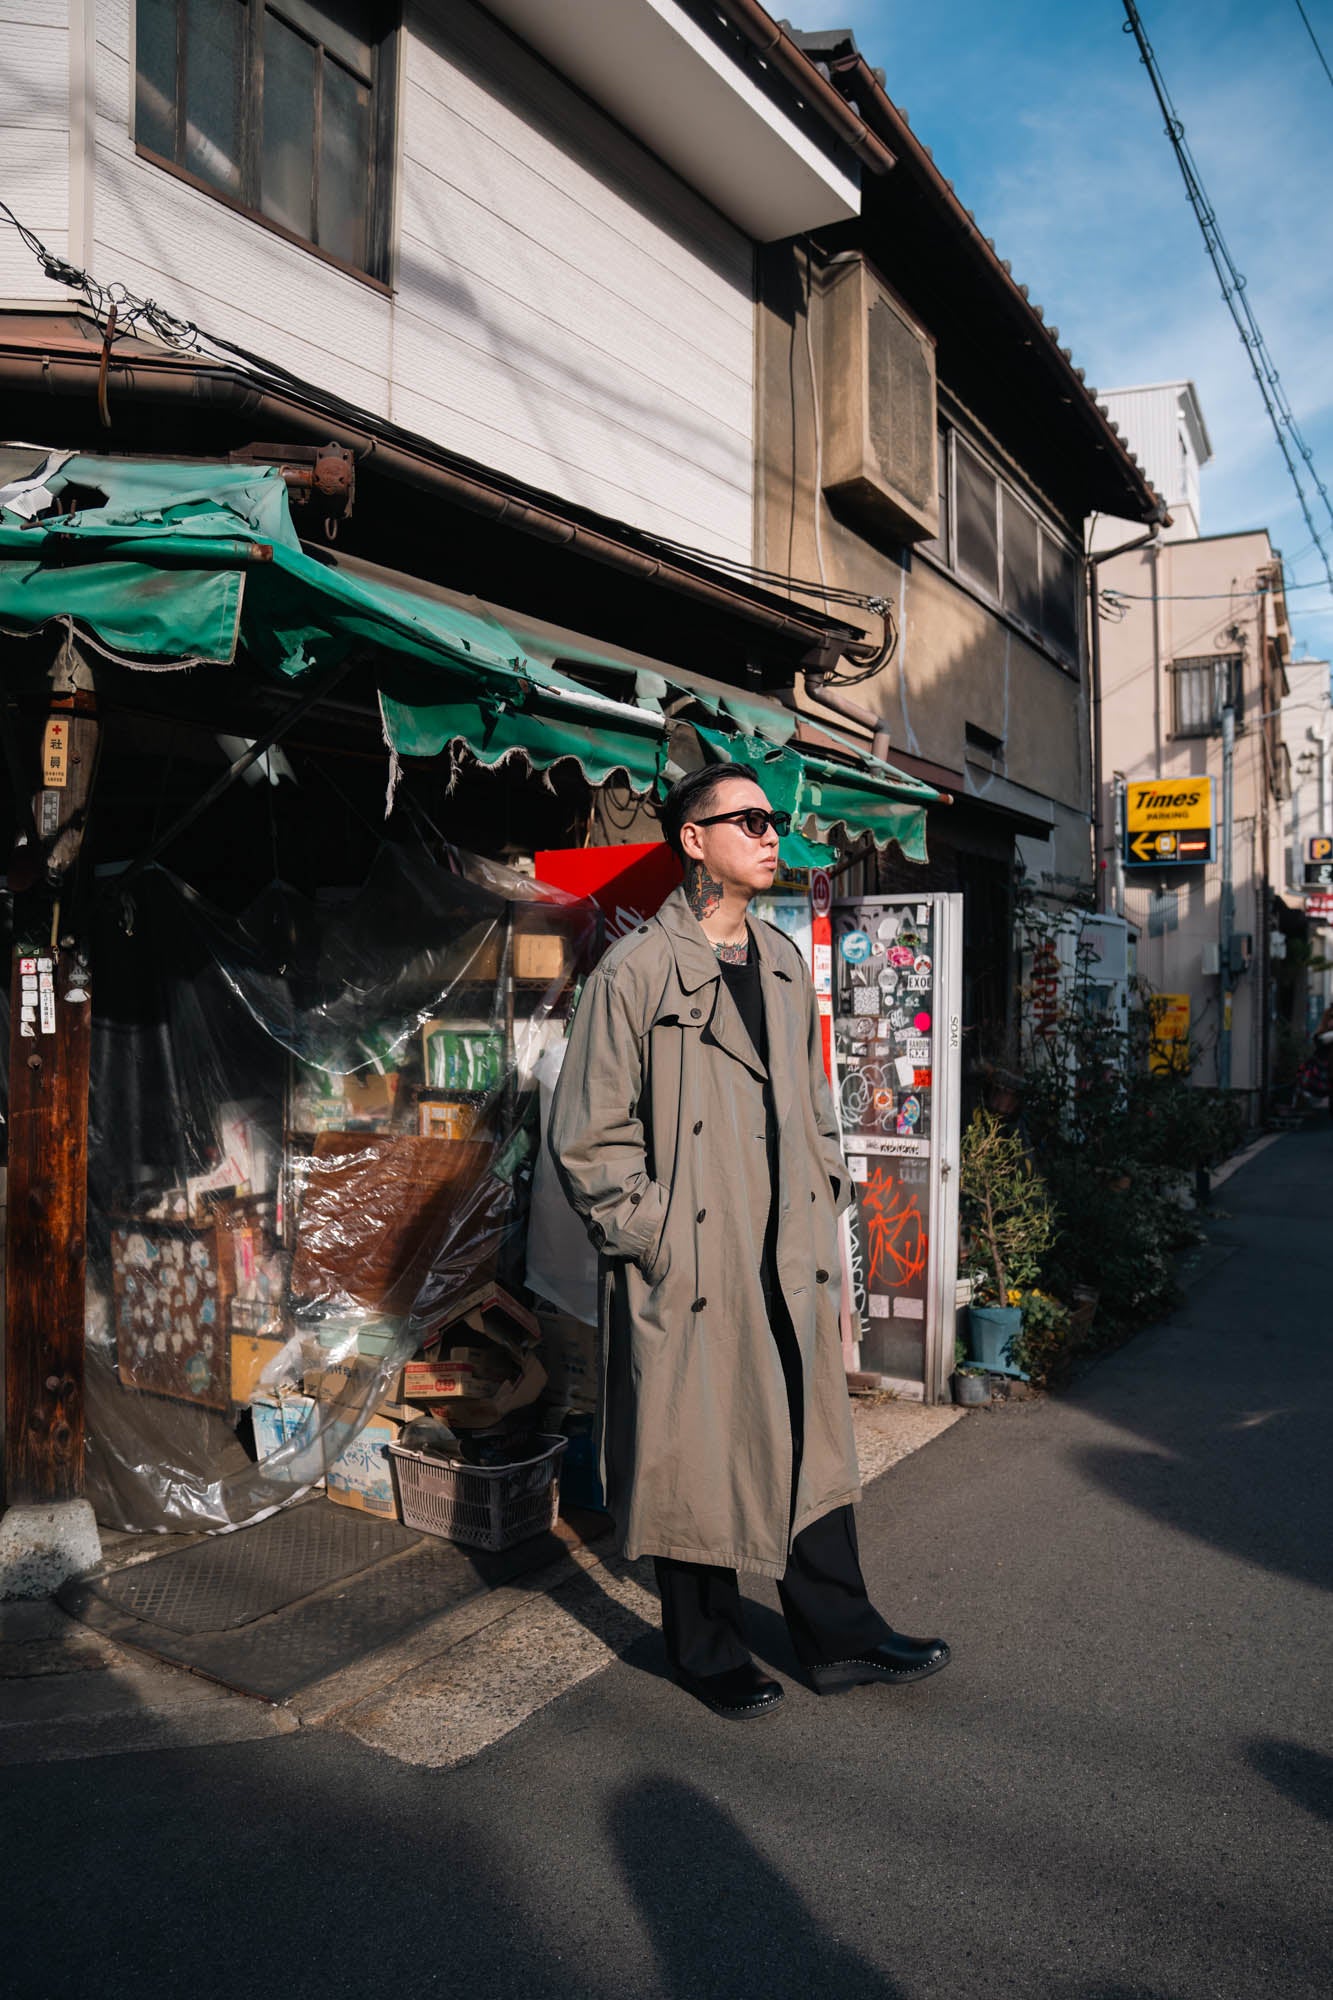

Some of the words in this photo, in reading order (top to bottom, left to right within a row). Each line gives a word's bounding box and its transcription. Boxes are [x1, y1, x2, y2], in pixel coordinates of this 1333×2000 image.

[1136, 791, 1201, 809] Times
[1146, 811, 1190, 820] PARKING
[1311, 839, 1332, 859] P
